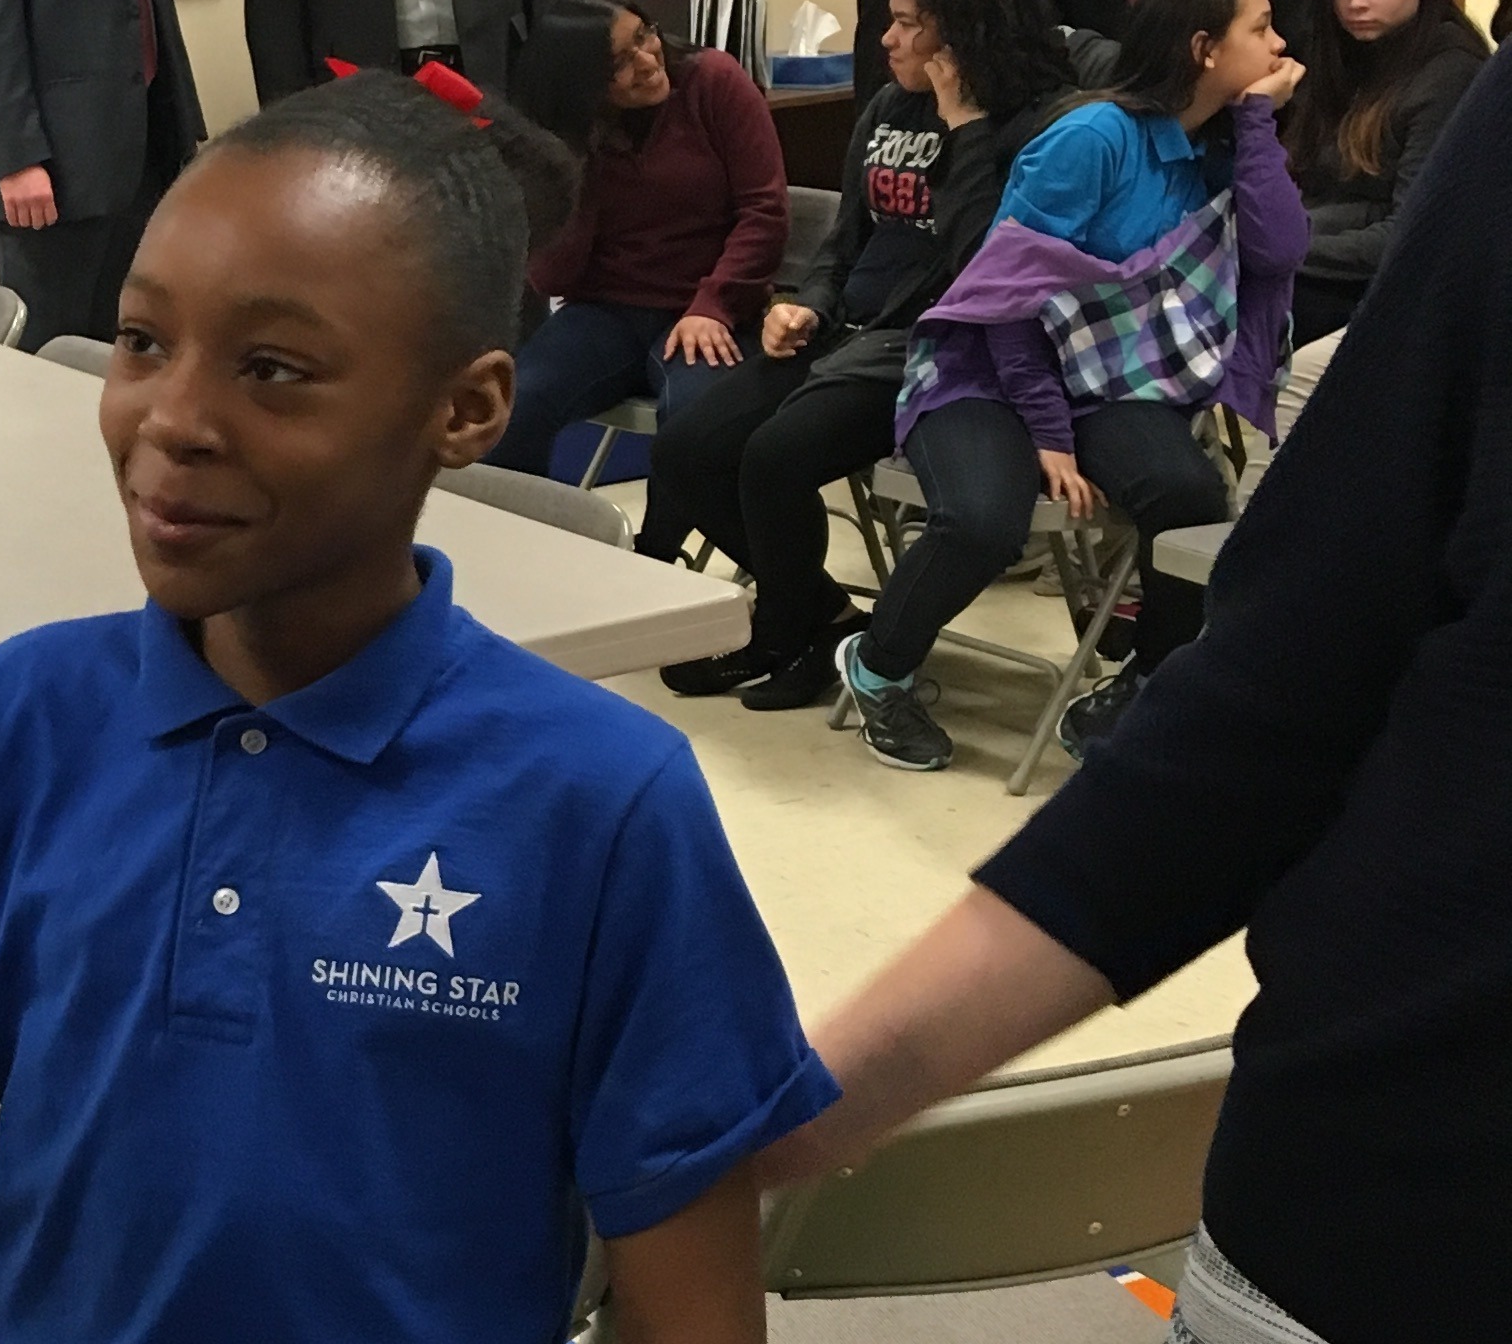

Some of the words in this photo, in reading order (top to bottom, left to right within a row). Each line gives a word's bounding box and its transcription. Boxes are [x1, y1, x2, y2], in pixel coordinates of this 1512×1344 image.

[312, 959, 438, 995] SHINING
[448, 976, 520, 1006] STAR
[326, 989, 415, 1010] CHRISTIAN
[420, 999, 501, 1021] SCHOOLS
